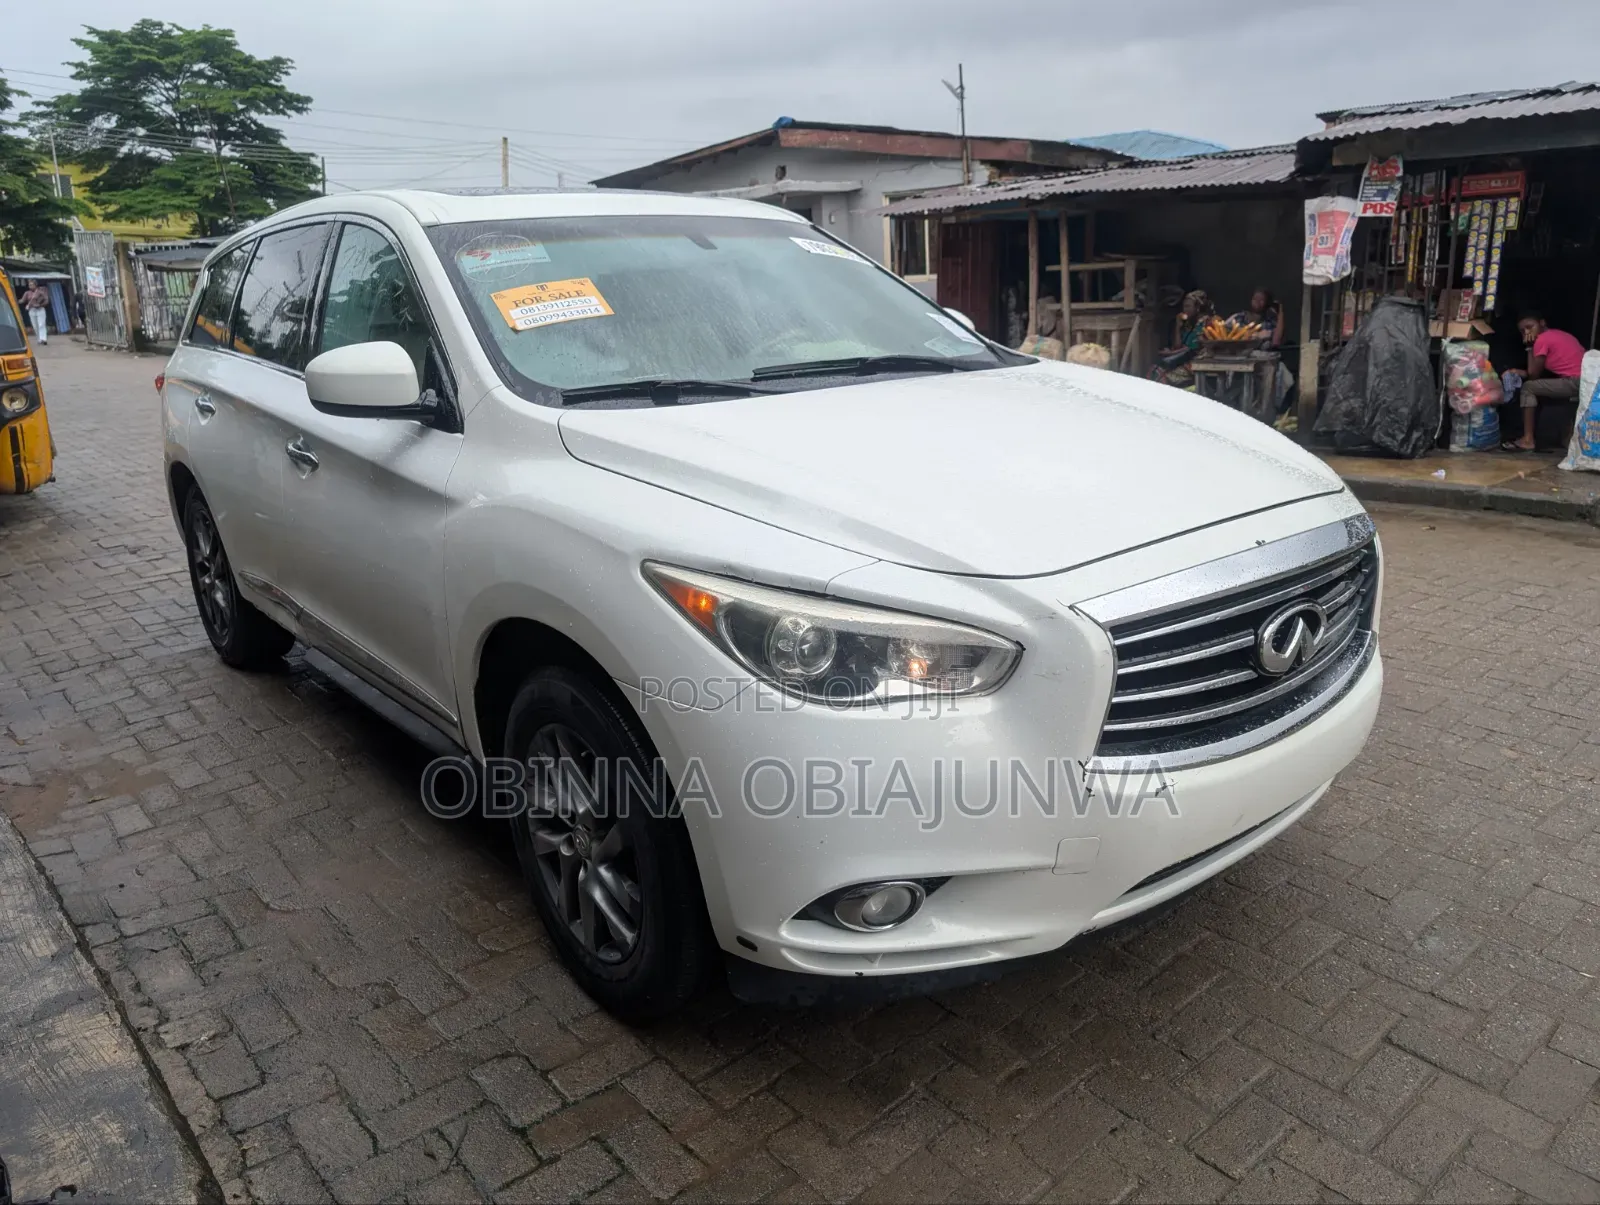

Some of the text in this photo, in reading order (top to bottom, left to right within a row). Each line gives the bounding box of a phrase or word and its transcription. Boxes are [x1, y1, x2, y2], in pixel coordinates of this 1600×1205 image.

[1361, 201, 1396, 215] POS
[512, 295, 545, 308] FOR
[548, 289, 586, 301] SALE
[520, 298, 592, 316] 08139112550
[523, 307, 601, 326] 08099433814
